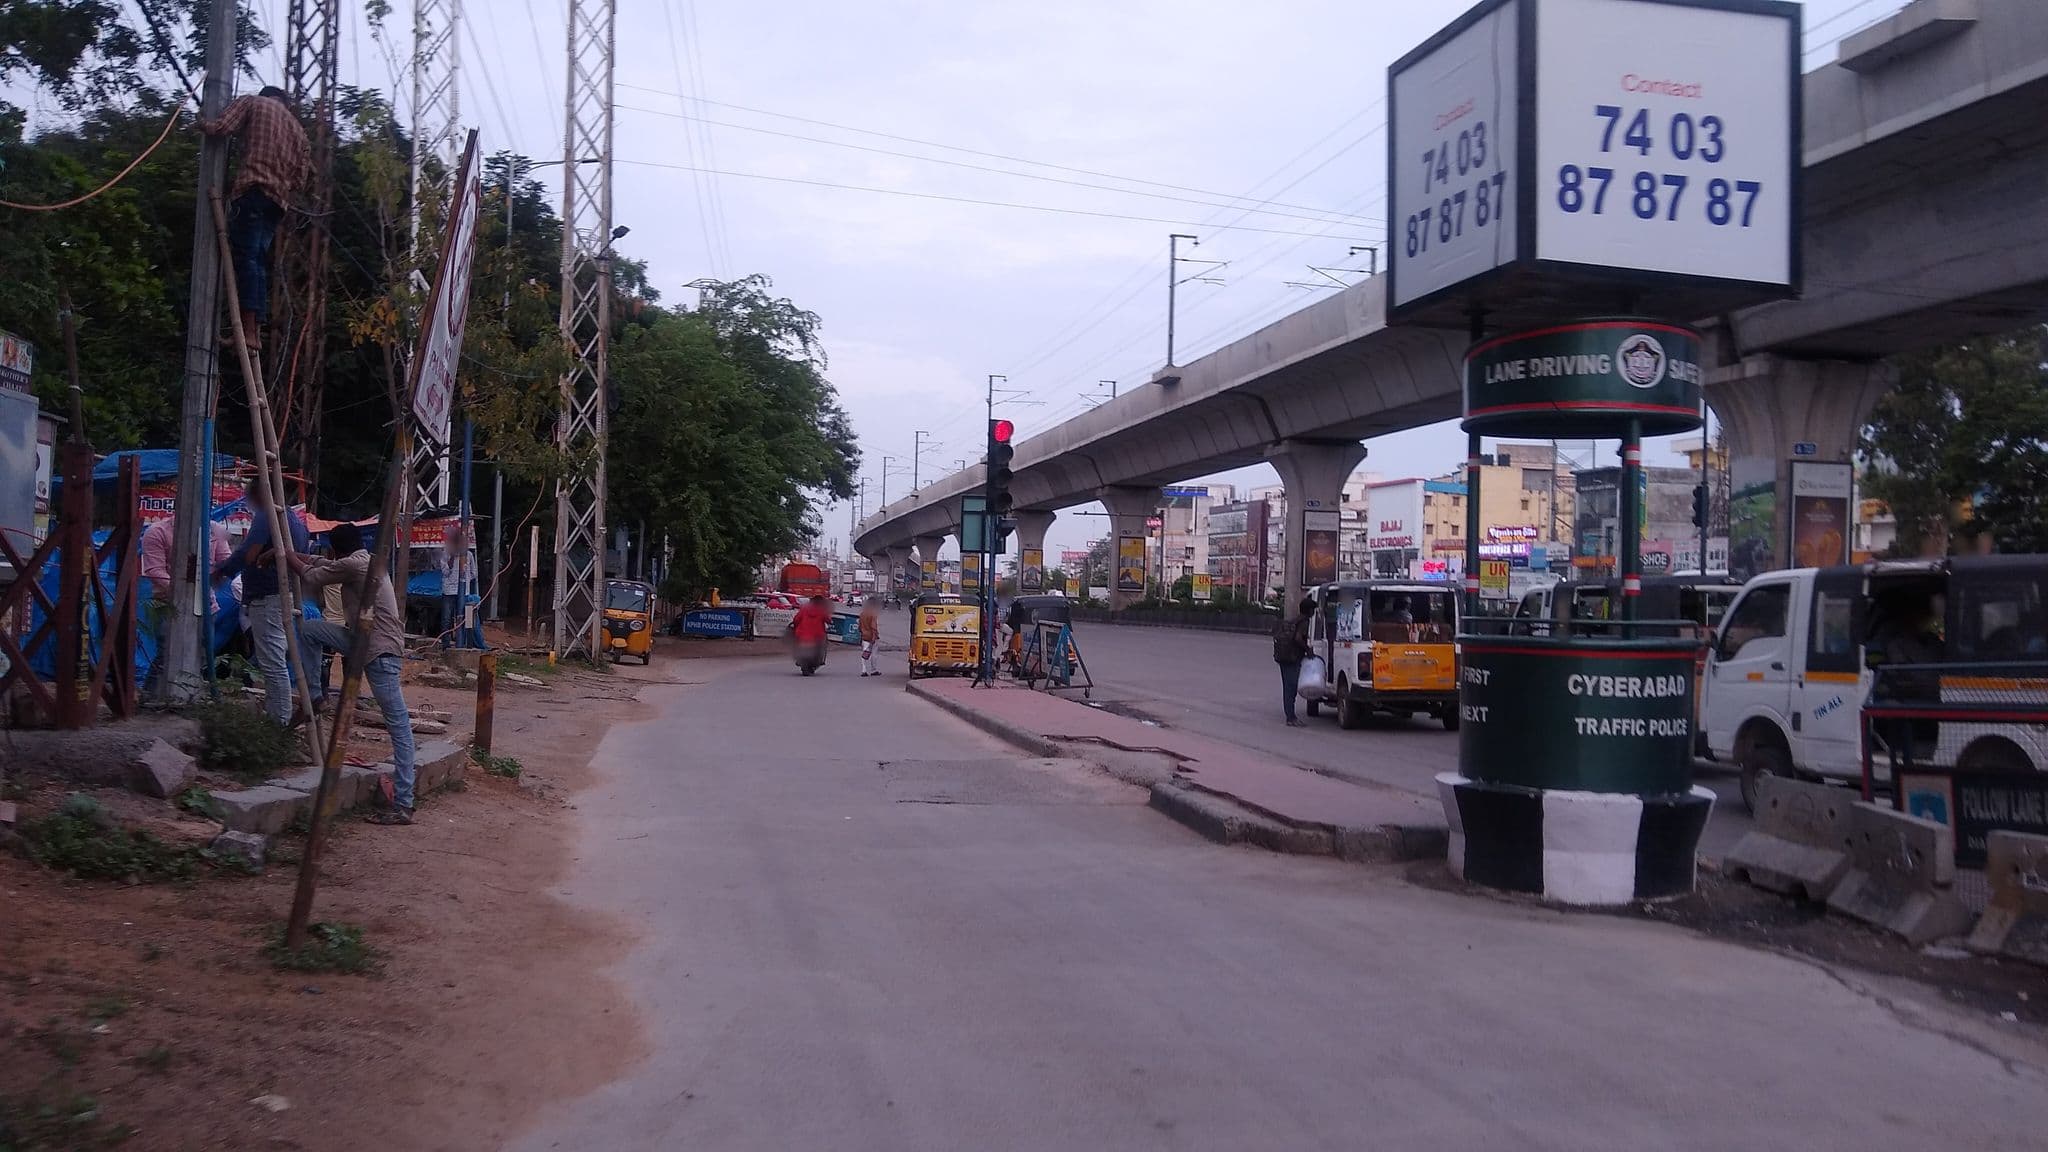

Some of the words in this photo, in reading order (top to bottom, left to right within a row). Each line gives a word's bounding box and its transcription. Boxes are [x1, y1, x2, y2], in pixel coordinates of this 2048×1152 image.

[1620, 73, 1704, 99] Contact
[1593, 104, 1655, 157] 74
[1669, 112, 1726, 163] 03
[1421, 139, 1450, 195] 74
[1456, 120, 1488, 177] 03
[1557, 164, 1615, 215] 87
[1632, 171, 1689, 222] 87
[1706, 177, 1762, 228] 87
[1406, 207, 1432, 259] 87
[1439, 190, 1468, 244] 87
[1475, 170, 1507, 228] 87
[1484, 358, 1526, 386] LANE
[1529, 353, 1612, 382] DRIVING
[1380, 520, 1402, 533] BAJAJ
[1370, 535, 1413, 549] ELECTRONICS
[1489, 562, 1507, 577] UK
[702, 622, 720, 630] POLICE
[721, 623, 742, 632] STATION
[708, 613, 731, 622] PARKING
[1567, 673, 1686, 699] CYBERABAD
[1575, 716, 1646, 737] TRAFFIC
[1648, 717, 1688, 737] POLICE
[1961, 786, 2009, 822] FOLLOW
[2012, 790, 2044, 825] LANE
